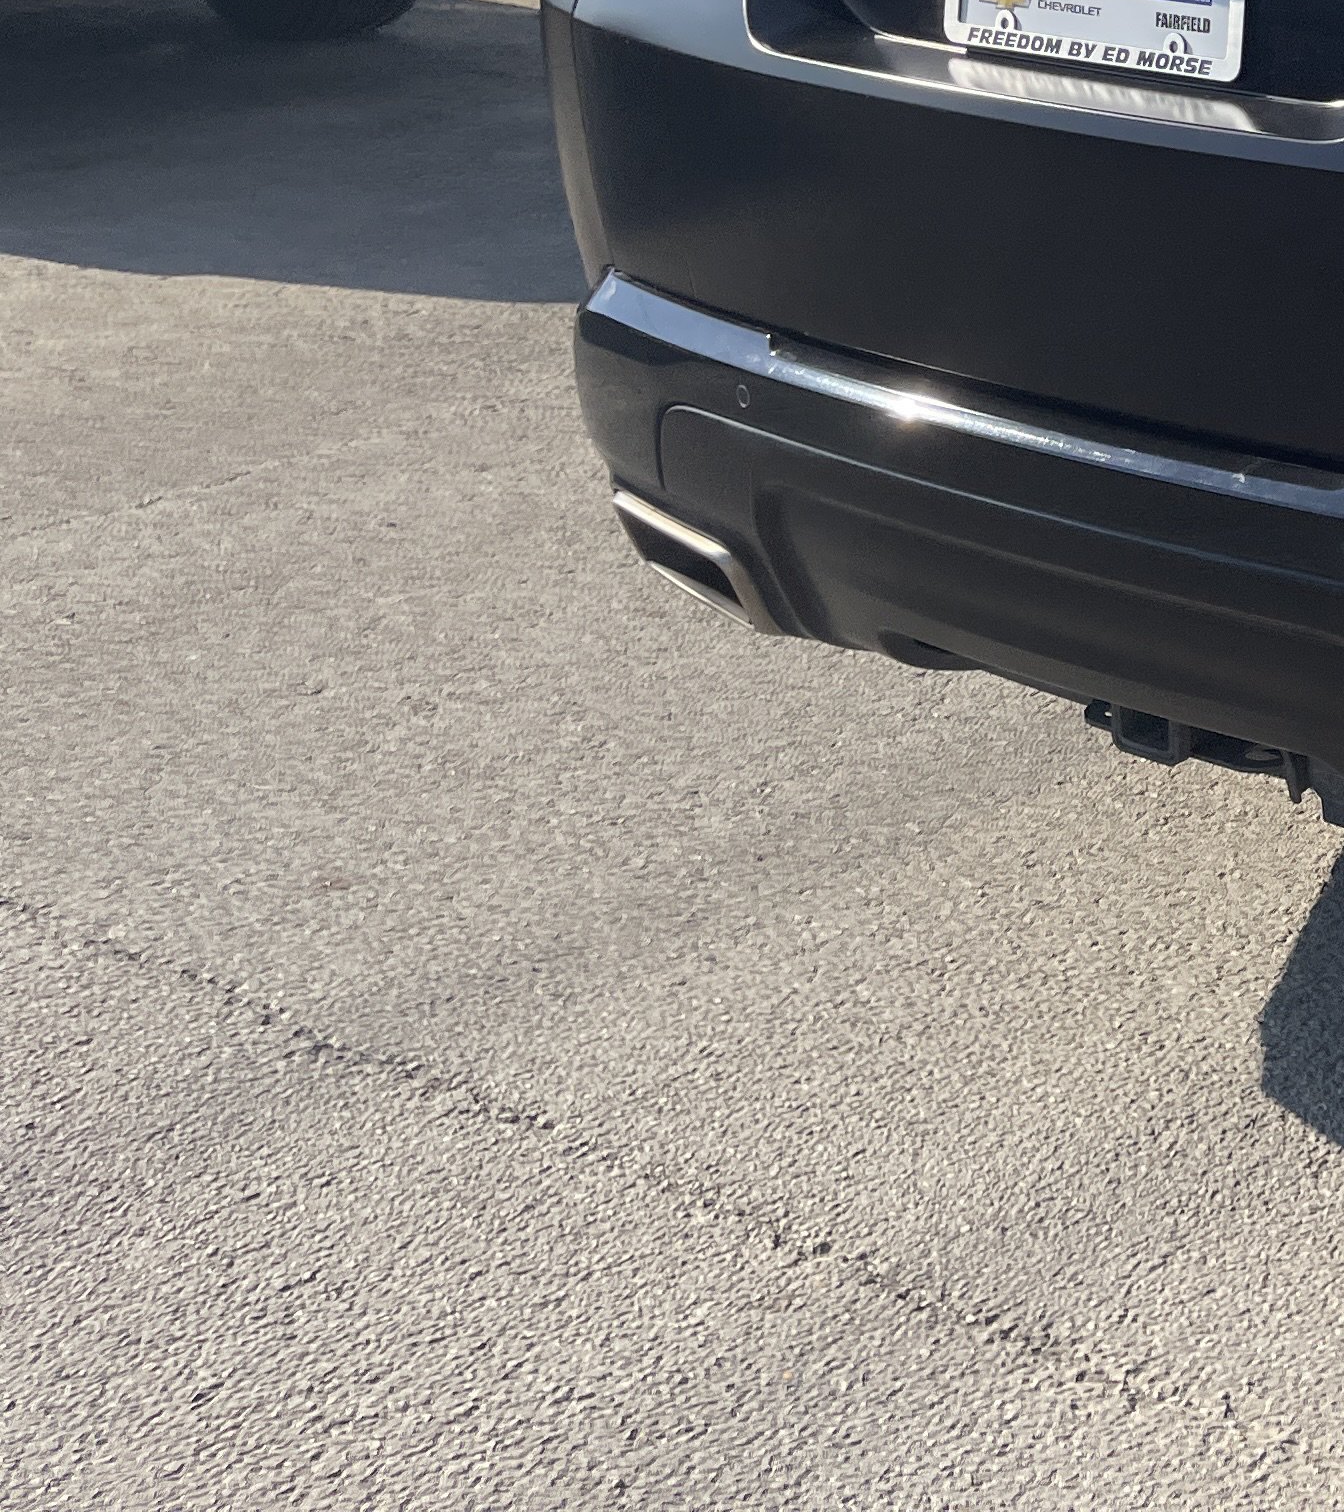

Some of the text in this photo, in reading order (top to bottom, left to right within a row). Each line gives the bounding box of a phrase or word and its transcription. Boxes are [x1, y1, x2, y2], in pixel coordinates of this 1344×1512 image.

[1037, 0, 1102, 17] CHEVROLET
[1156, 11, 1211, 34] FAIRFIELD
[967, 27, 1213, 76] FREEDOM BY ED MORSE
